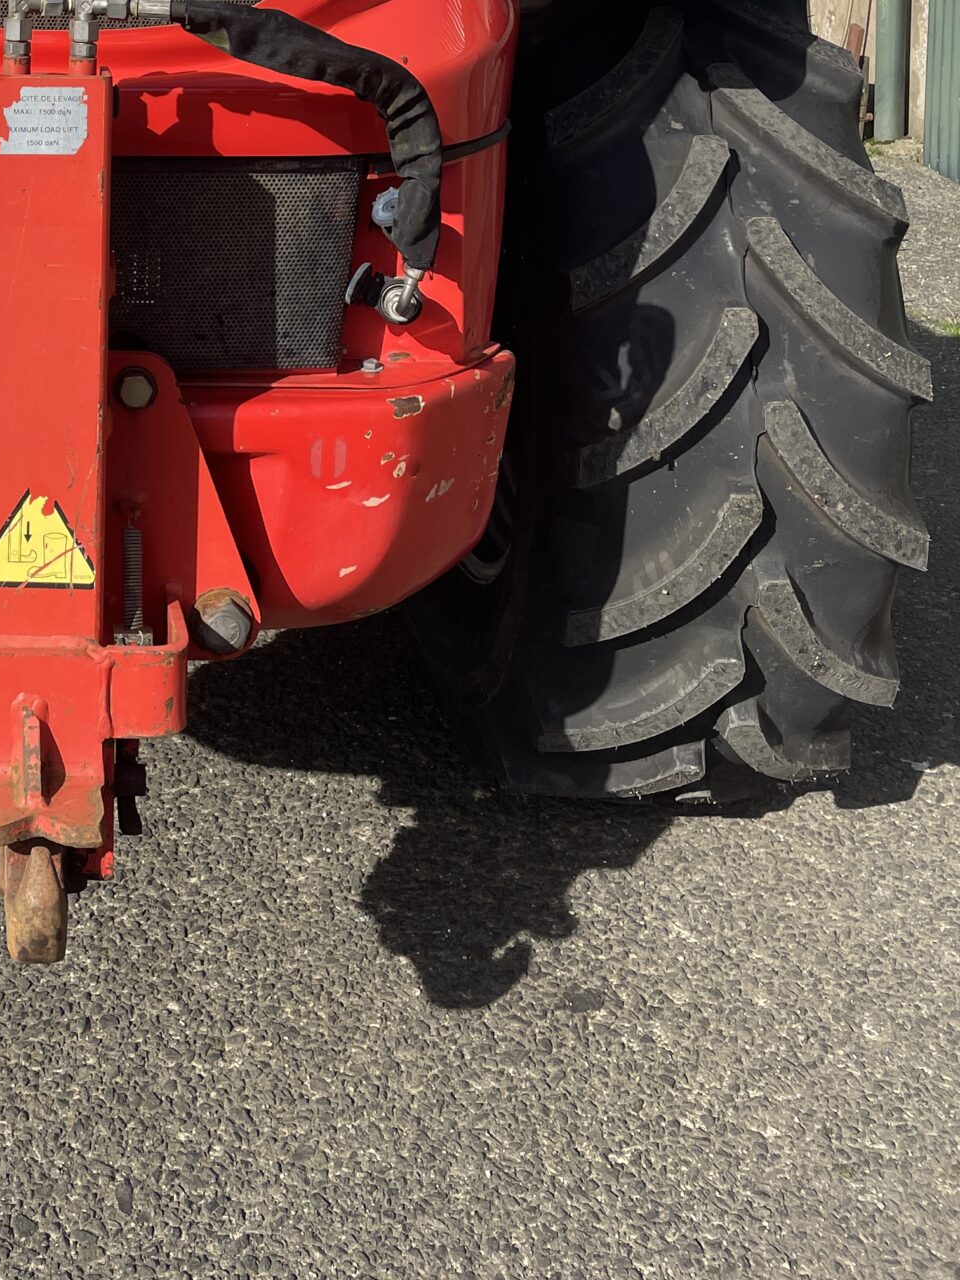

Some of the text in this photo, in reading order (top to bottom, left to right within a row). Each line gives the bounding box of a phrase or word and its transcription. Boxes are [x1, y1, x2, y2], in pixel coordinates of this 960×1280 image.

[39, 108, 56, 116] 1500
[26, 139, 59, 147] 1500 daN
